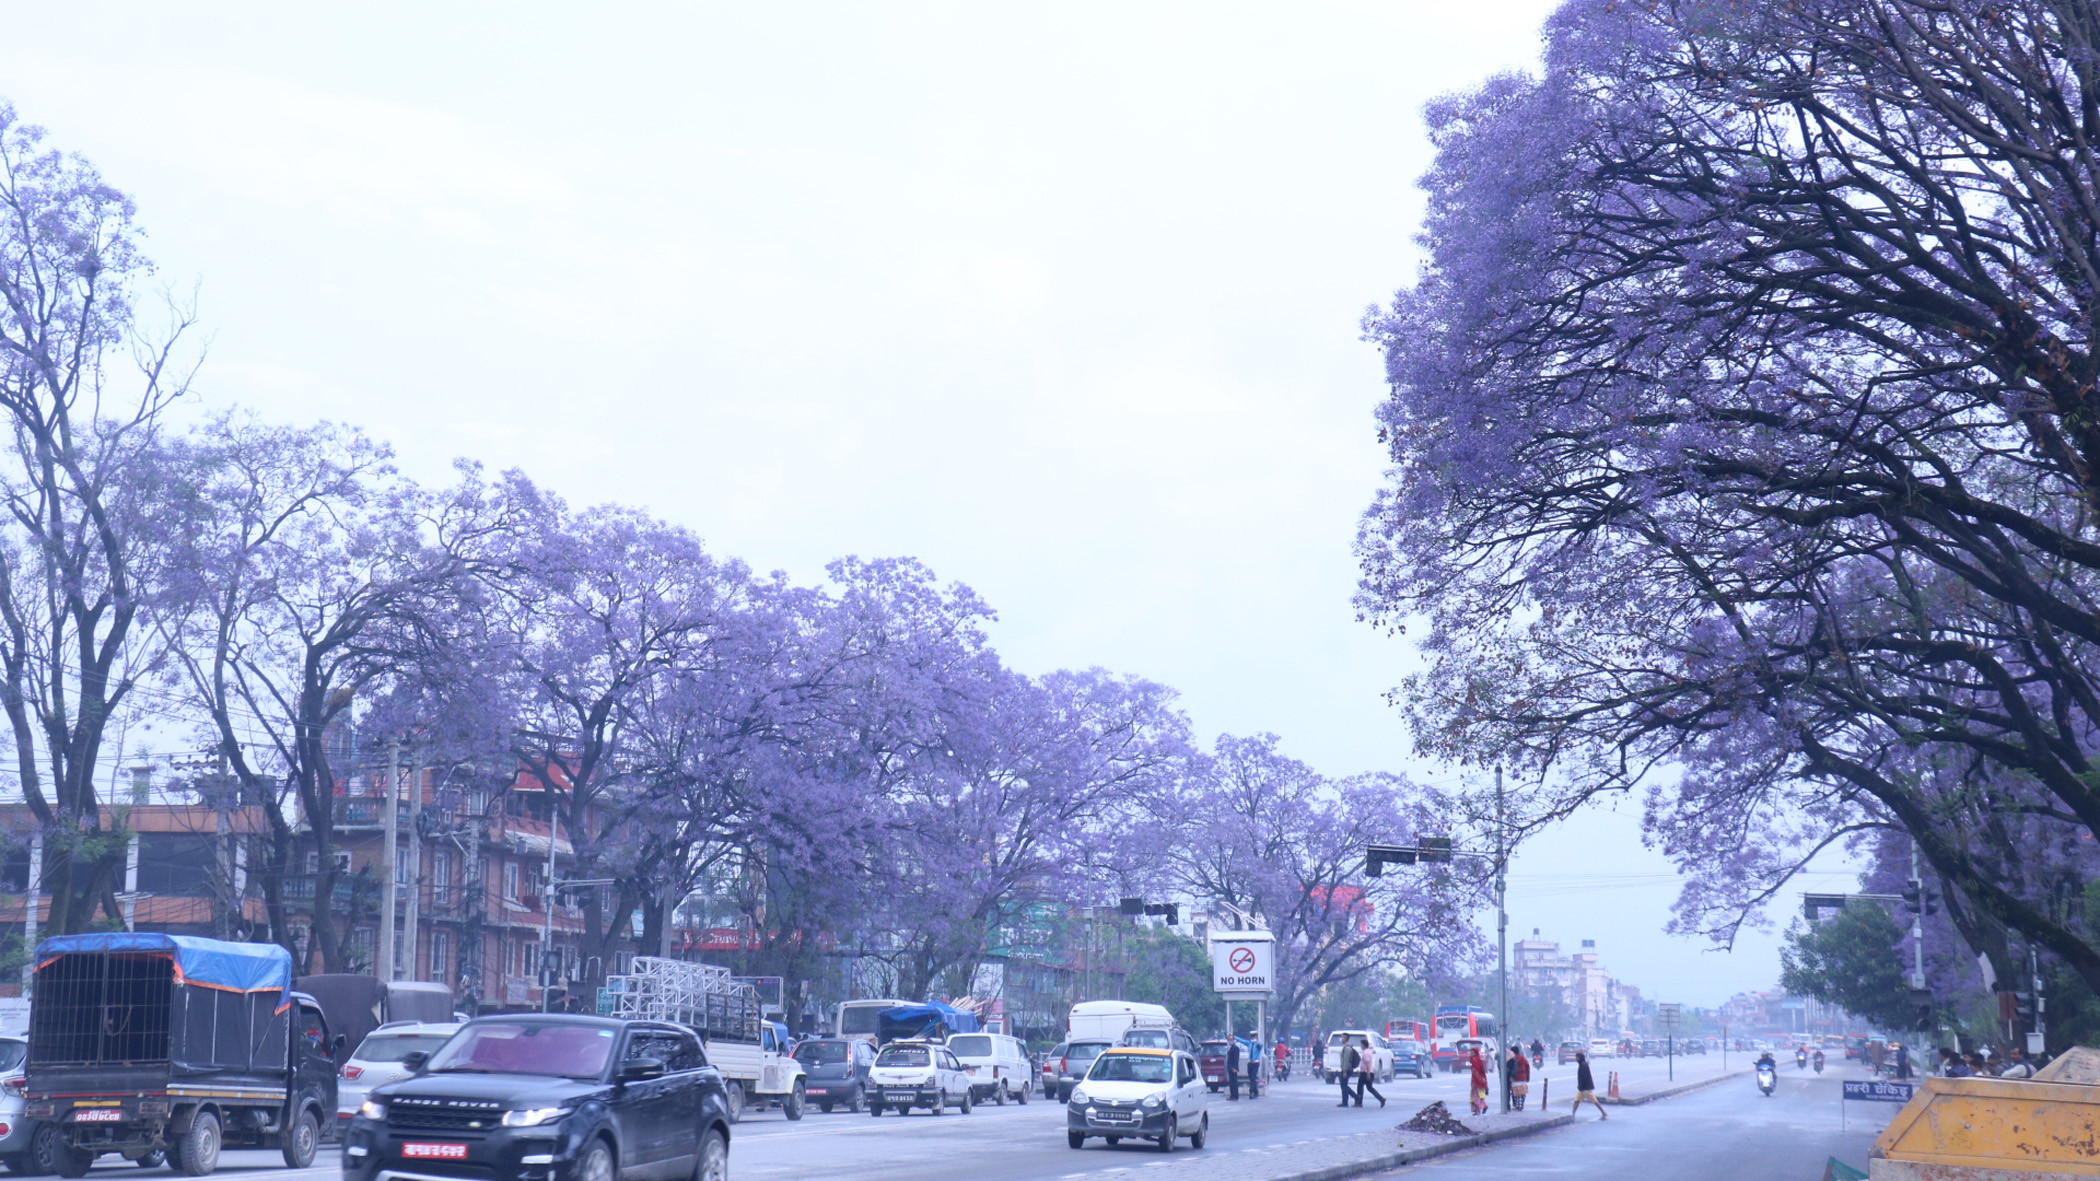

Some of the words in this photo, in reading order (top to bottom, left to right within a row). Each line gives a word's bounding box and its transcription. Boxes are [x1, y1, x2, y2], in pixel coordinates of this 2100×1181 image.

[1221, 977, 1235, 985] NO
[1237, 976, 1265, 985] HORN
[1845, 1082, 1870, 1094] प्रहरी
[392, 1098, 441, 1106] RANGE
[448, 1101, 500, 1109] ROVER
